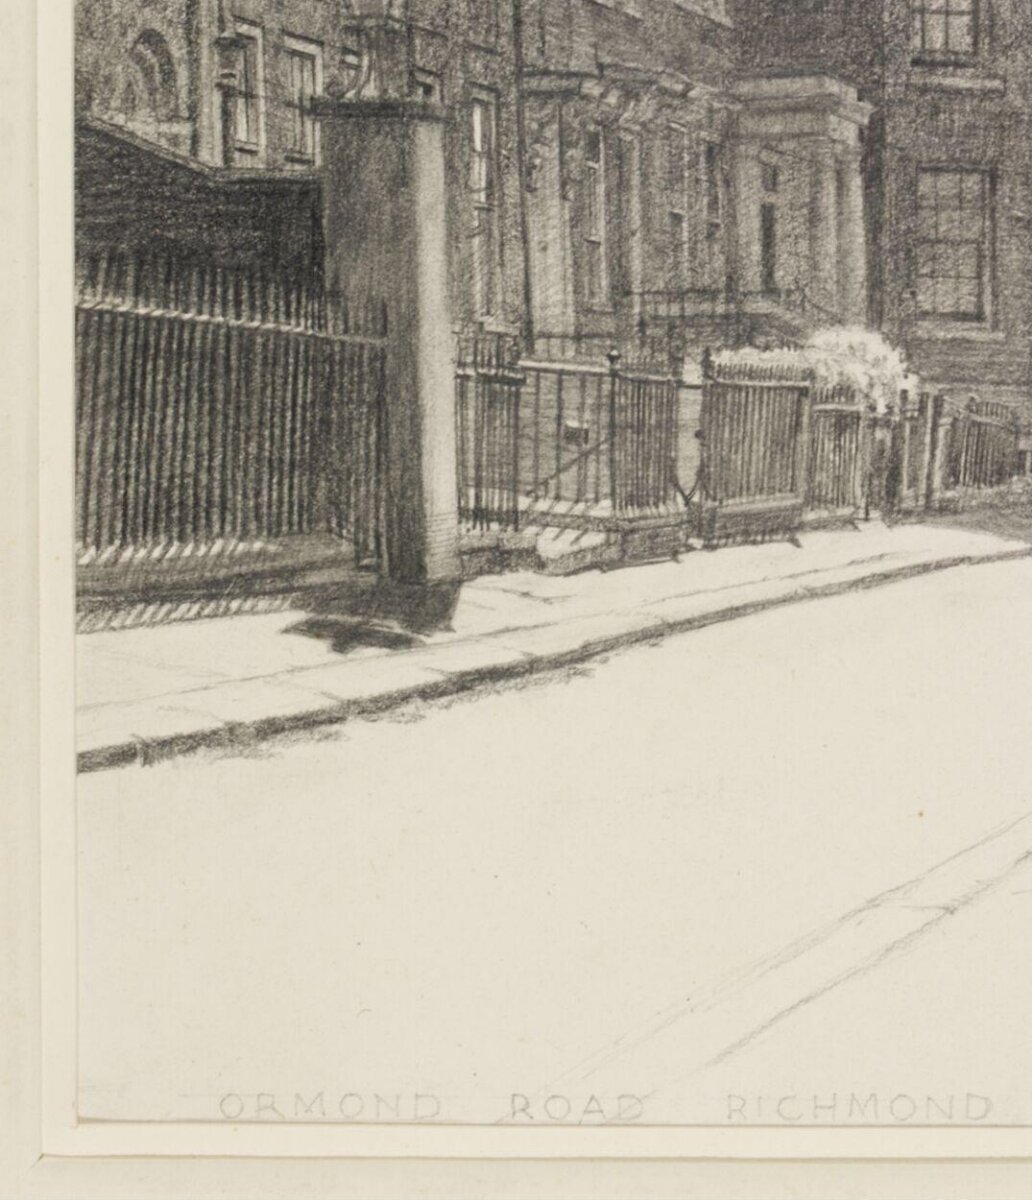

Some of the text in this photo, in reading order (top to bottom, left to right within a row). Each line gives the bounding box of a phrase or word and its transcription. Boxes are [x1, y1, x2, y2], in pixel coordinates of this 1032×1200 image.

[219, 1092, 440, 1120] ORMOND
[510, 1092, 646, 1124] ROAD
[727, 1092, 994, 1121] RICHMOND
